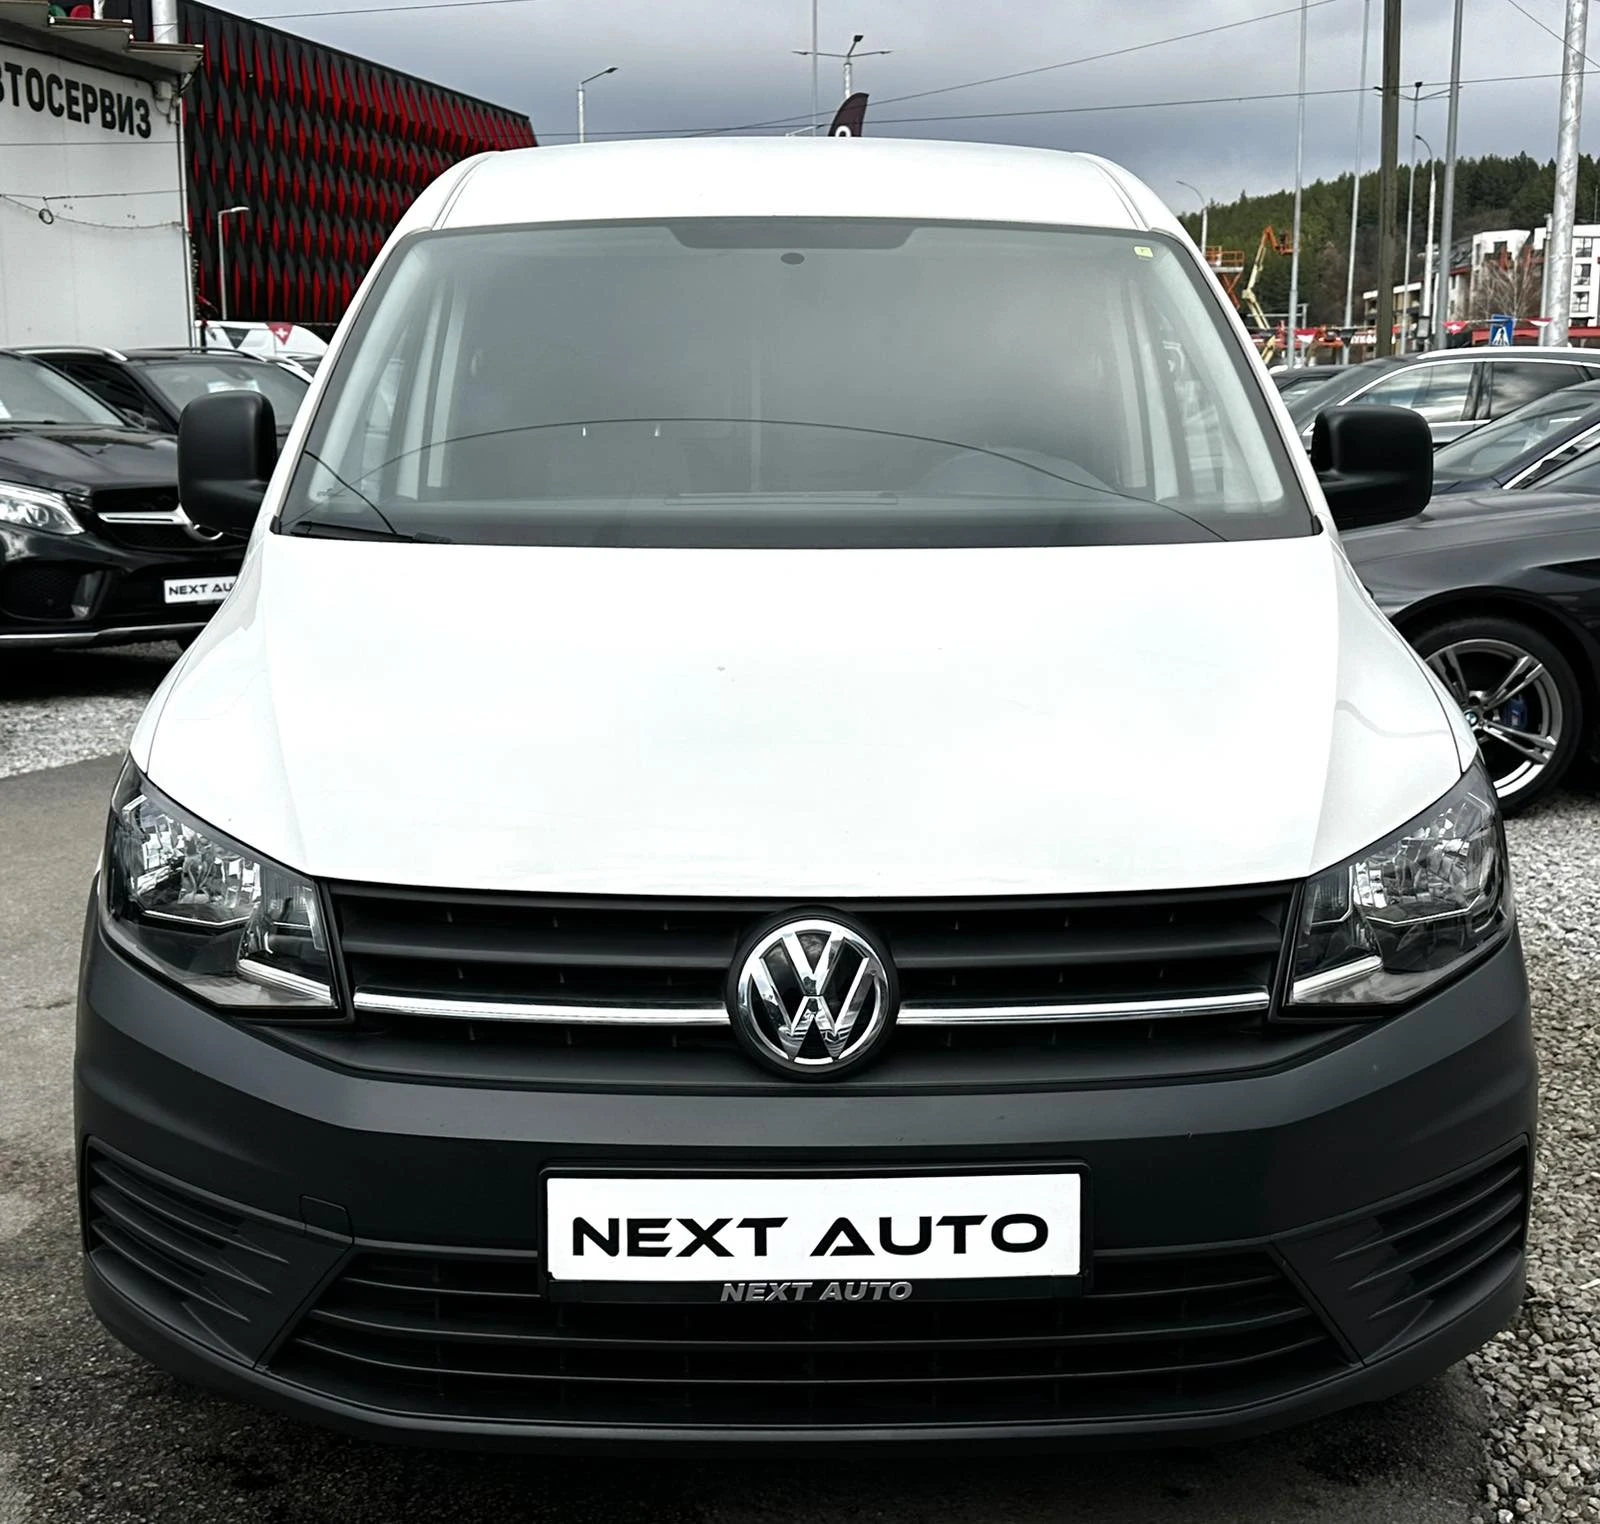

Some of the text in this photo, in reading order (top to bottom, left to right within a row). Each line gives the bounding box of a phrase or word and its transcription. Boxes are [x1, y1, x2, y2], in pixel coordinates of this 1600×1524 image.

[168, 584, 208, 596] NEXT
[573, 1213, 1049, 1258] NEXT AUTO
[720, 1281, 913, 1302] NEXT AUTO
